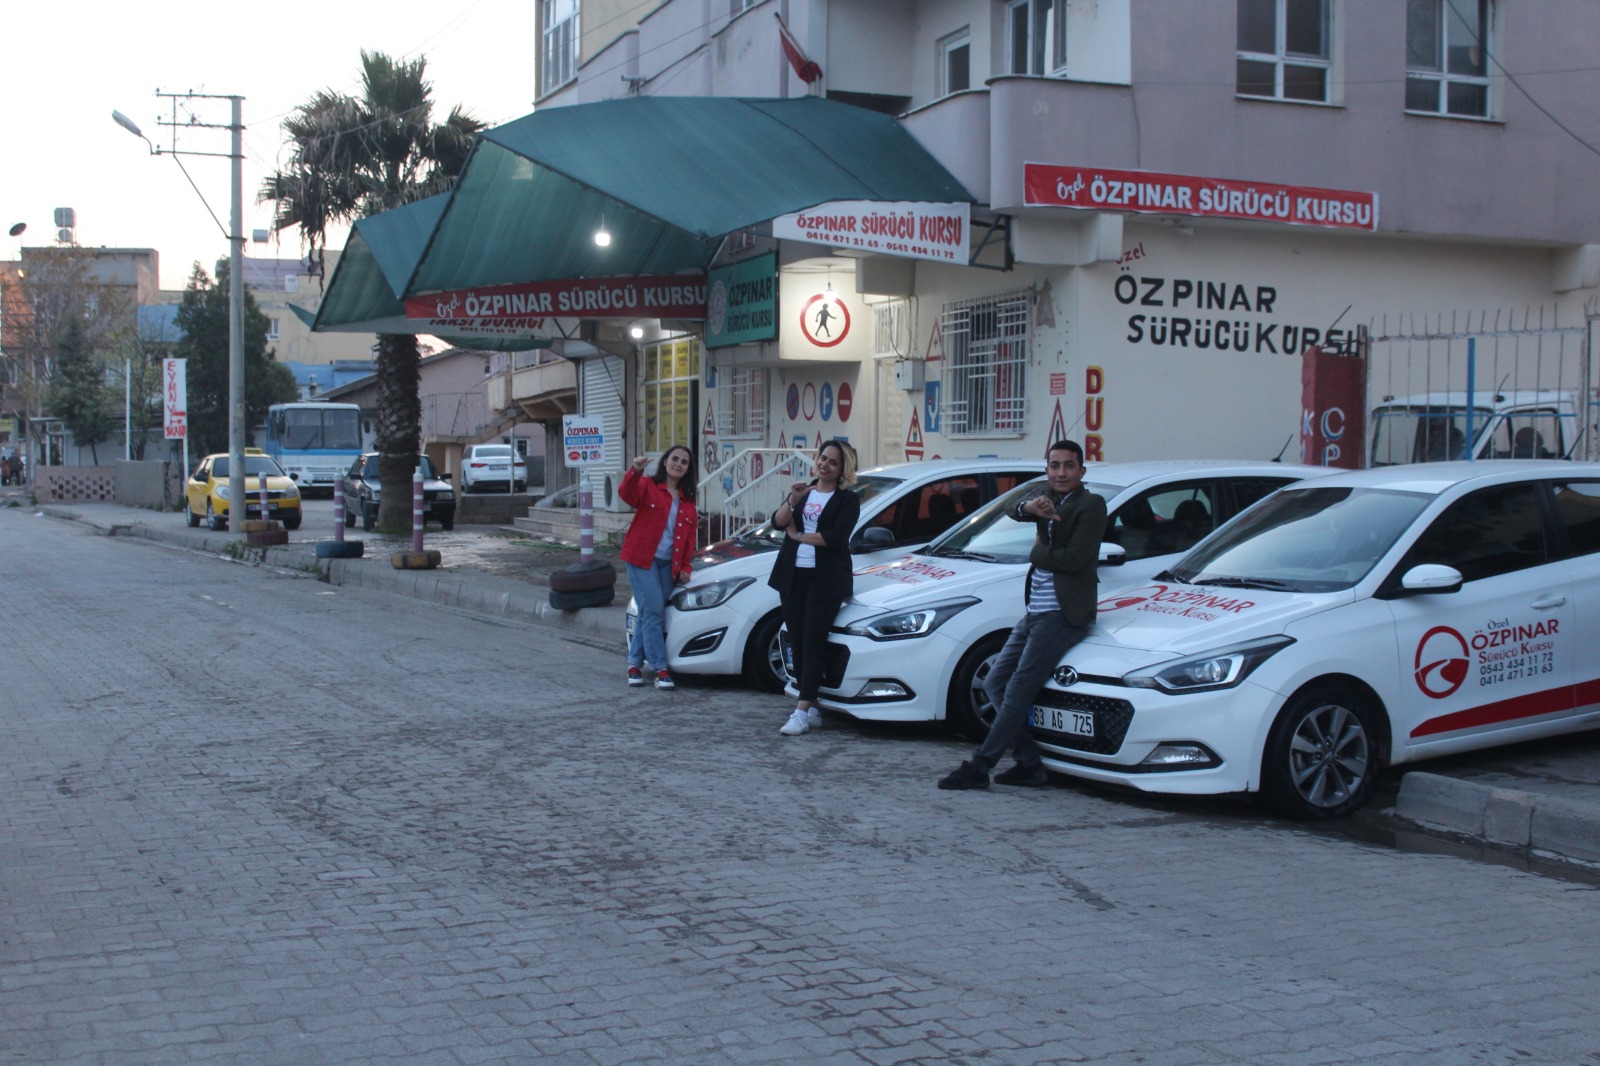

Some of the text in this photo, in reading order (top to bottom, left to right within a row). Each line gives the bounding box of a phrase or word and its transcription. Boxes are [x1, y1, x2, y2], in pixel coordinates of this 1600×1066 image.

[1056, 173, 1372, 226] Özel ÖZPINAR SÜRÜCÜ KURSU
[796, 211, 963, 247] ÖZPINAR SÜRÜCÜ KURSU
[806, 231, 830, 242] 0414
[833, 234, 850, 244] 471
[853, 237, 864, 246] 21
[931, 248, 941, 257] 11
[944, 250, 955, 259] 72
[1114, 243, 1146, 265] zel
[436, 284, 707, 318] Özel ÖZPINAR SÜRÜCÜ KURSU
[728, 277, 773, 308] ÖZPINAR
[1114, 266, 1277, 313] ÖZPINAR
[751, 308, 773, 330] KURSU
[1085, 366, 1104, 462] DUR
[567, 427, 599, 436] ÖZPINAR
[1154, 589, 1256, 613] ÖZPINAR
[1471, 619, 1559, 650] ÖZPINAR
[1487, 617, 1509, 630] Özel
[1480, 651, 1553, 675] 0543 434 11 72
[1480, 662, 1553, 687] 0414 471 21 63
[1033, 707, 1092, 735] 63 AG 725
